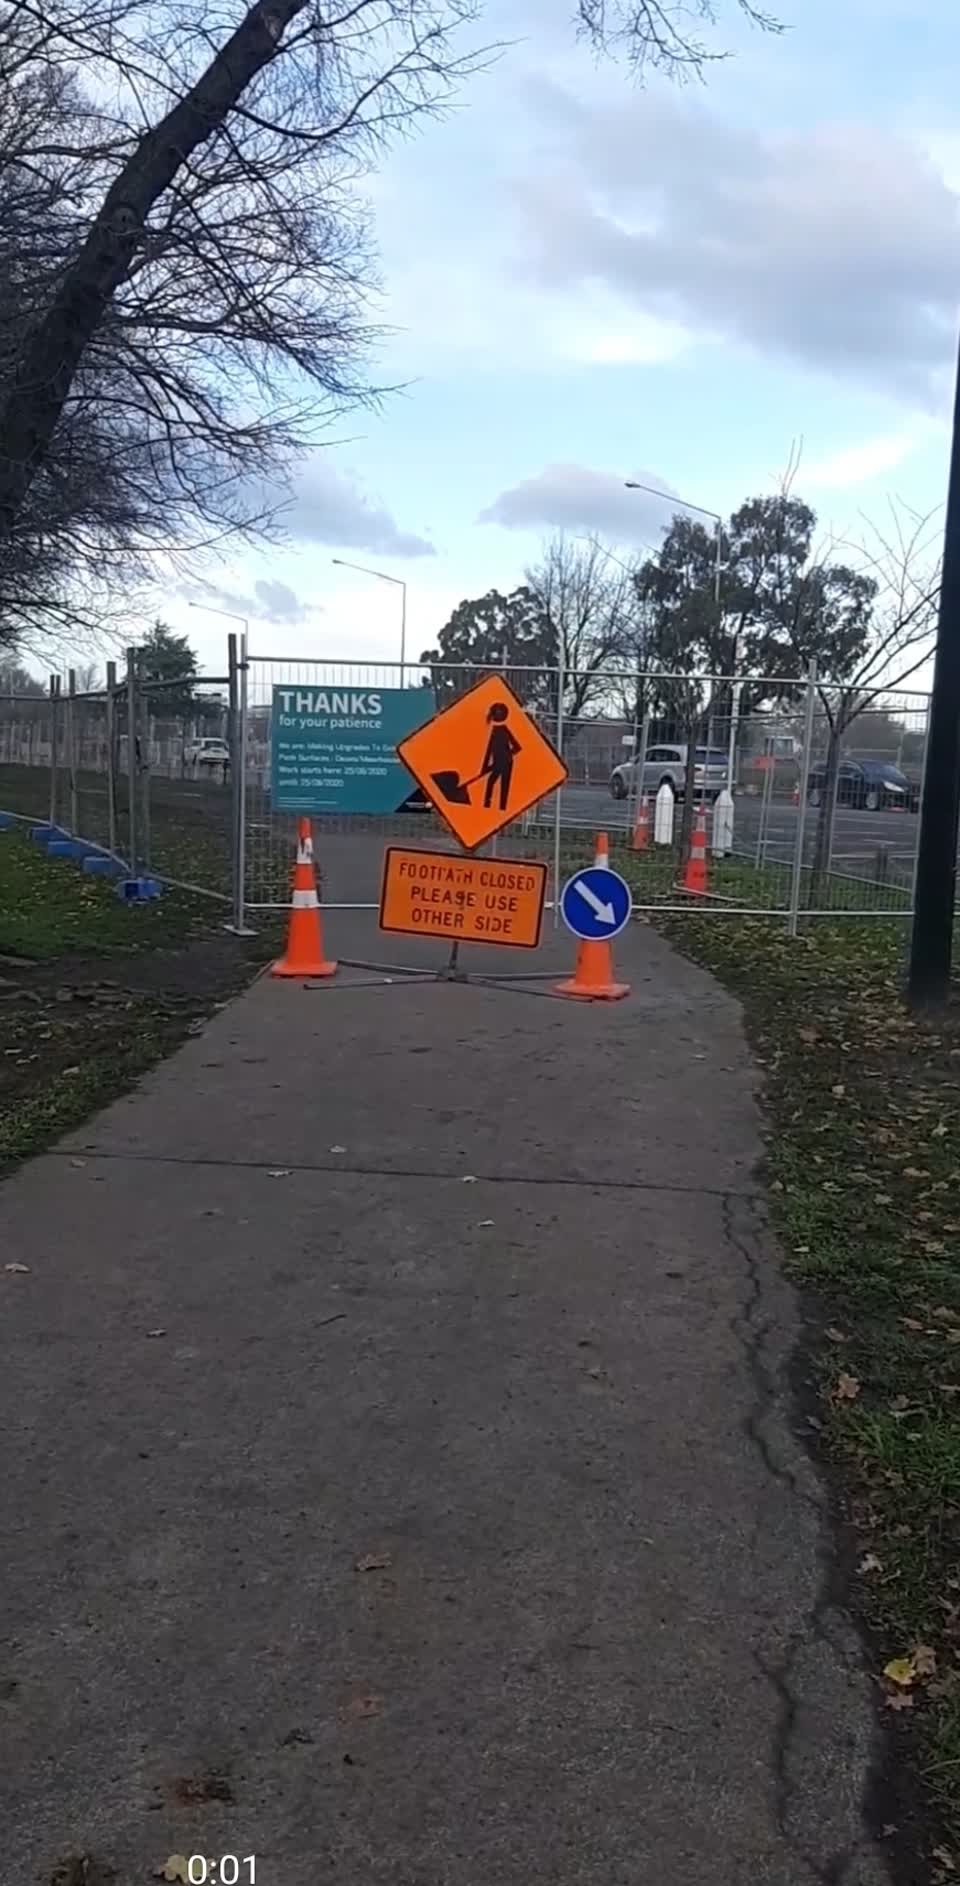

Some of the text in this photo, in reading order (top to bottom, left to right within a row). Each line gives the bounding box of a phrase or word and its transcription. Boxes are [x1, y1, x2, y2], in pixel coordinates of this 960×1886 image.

[279, 691, 382, 715] THANKS
[279, 714, 382, 730] for your patience
[399, 862, 535, 891] FOOTPATH CLOSED
[411, 886, 518, 912] PLEASE USE
[411, 908, 512, 934] OTHER SIDE
